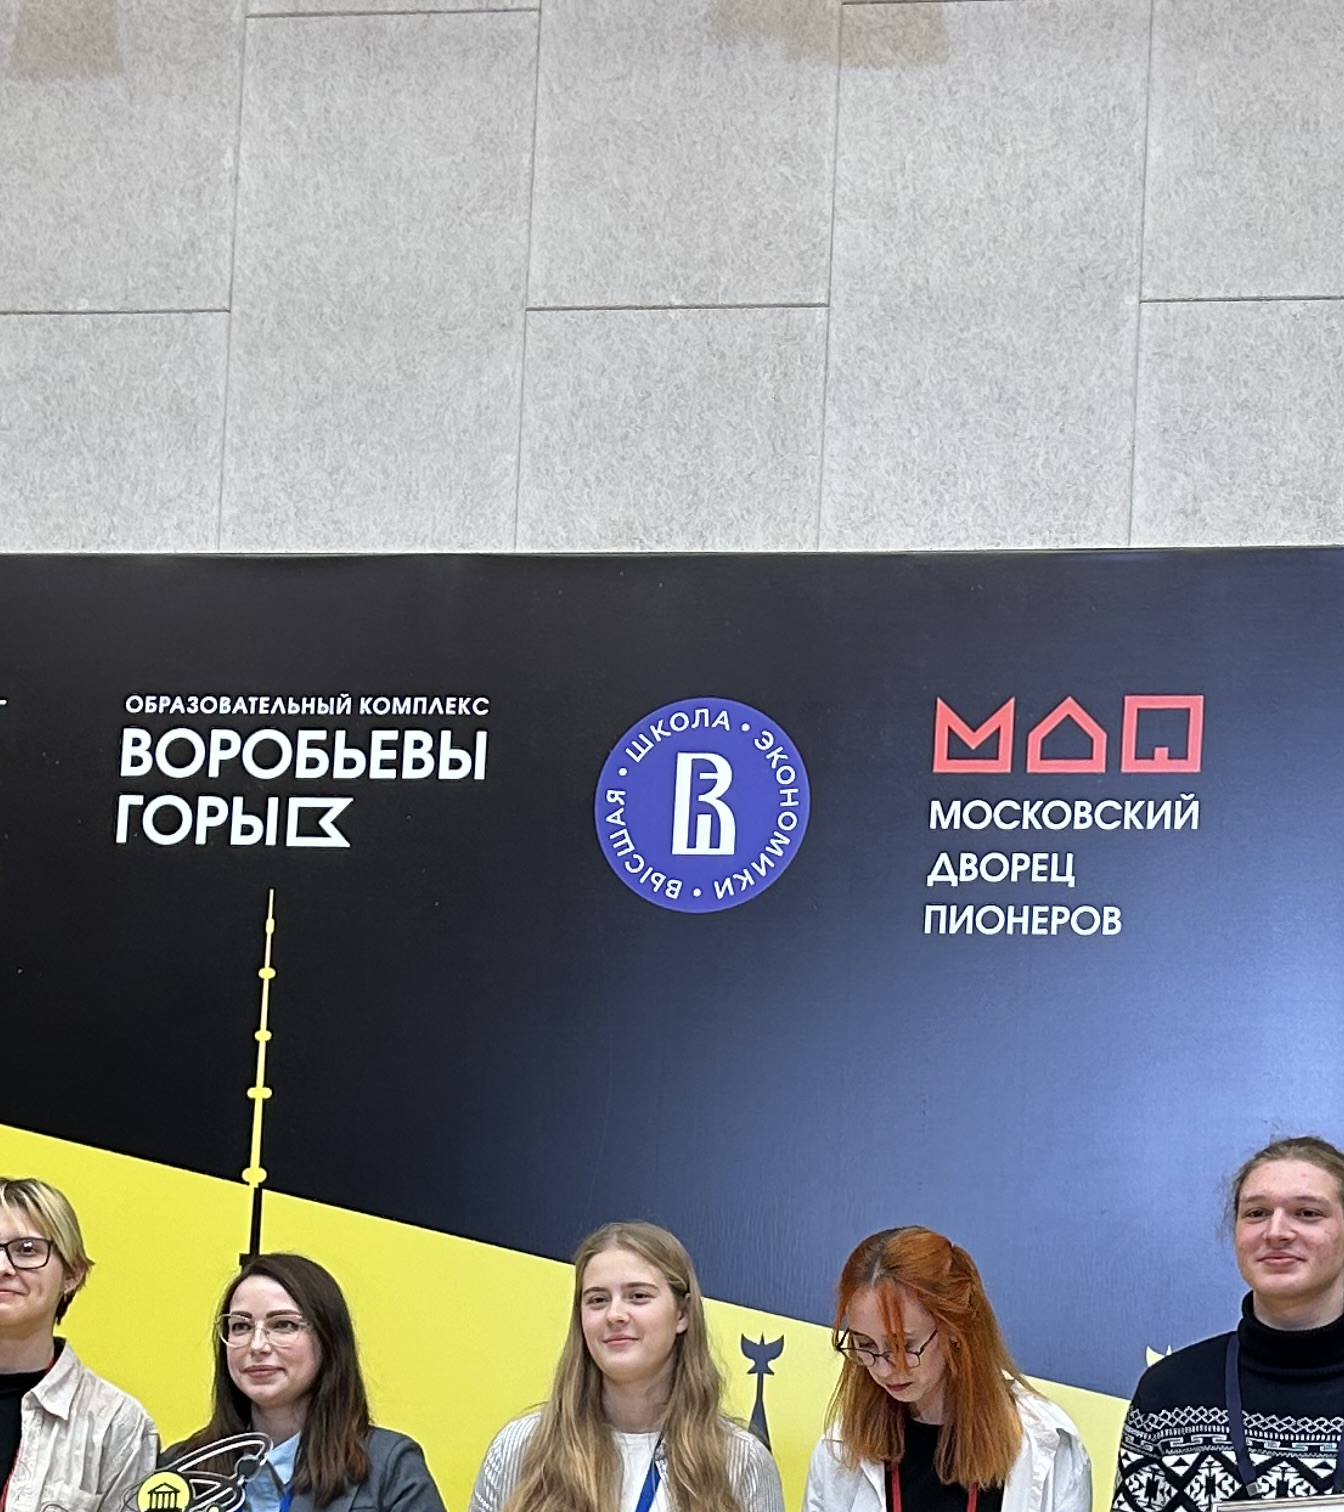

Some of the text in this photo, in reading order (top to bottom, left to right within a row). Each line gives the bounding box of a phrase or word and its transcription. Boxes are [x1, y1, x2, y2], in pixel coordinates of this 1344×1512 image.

[124, 690, 490, 716] ОБРАЗОВАТЕЛЬНЫЙ КОМПЛЕКС
[120, 727, 488, 781] ВОРОБЬЕВЫ
[115, 794, 279, 847] ГОРЫ
[605, 707, 800, 900] ВЫСШАЯ ШКОЛА ЭКОНОМИКИ
[928, 792, 1201, 831] МОСКОВСКИЙ
[926, 852, 1076, 888] ДВОРЕЦ
[923, 904, 1123, 937] ПИОНЕРОВ
